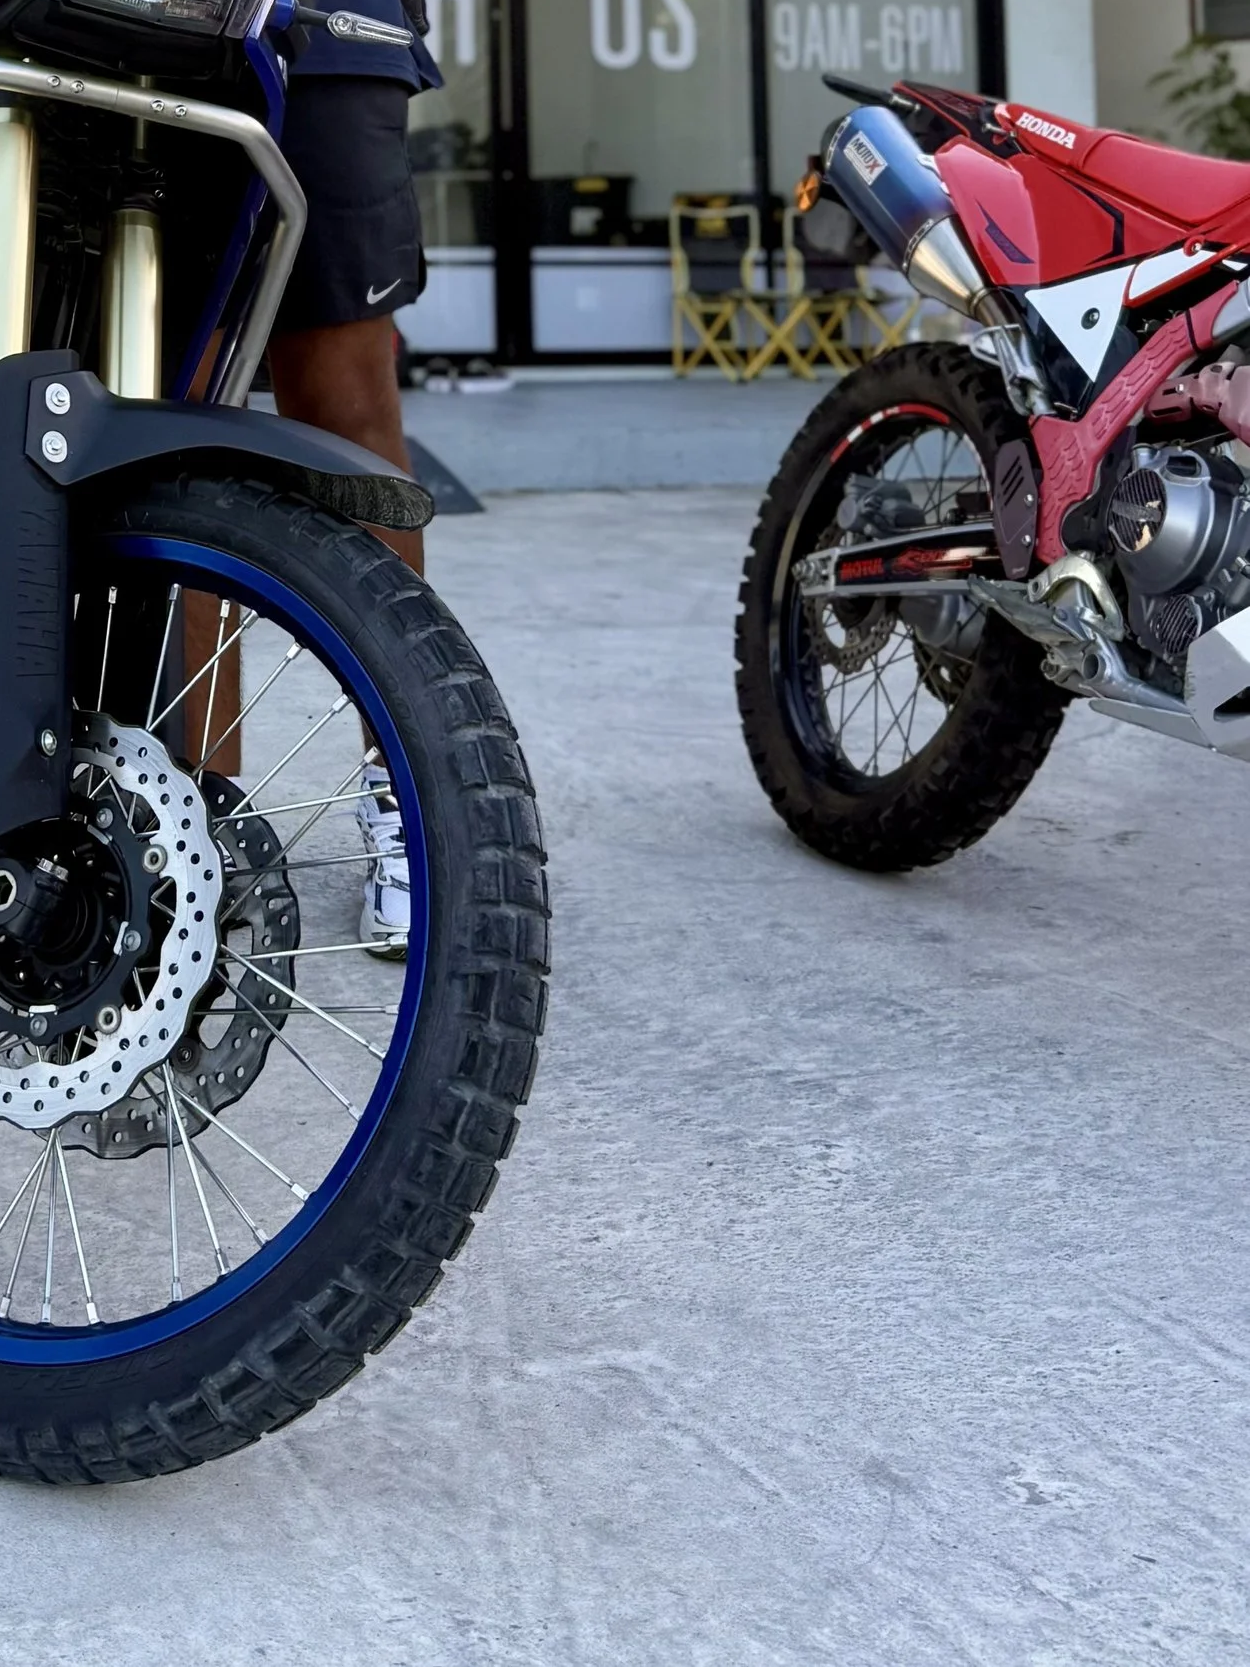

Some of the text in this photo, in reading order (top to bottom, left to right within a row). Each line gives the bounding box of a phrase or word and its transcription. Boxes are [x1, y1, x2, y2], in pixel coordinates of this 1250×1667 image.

[1015, 111, 1078, 150] HONDA
[840, 557, 884, 581] MOTUL
[15, 501, 62, 677] YAMAHA
